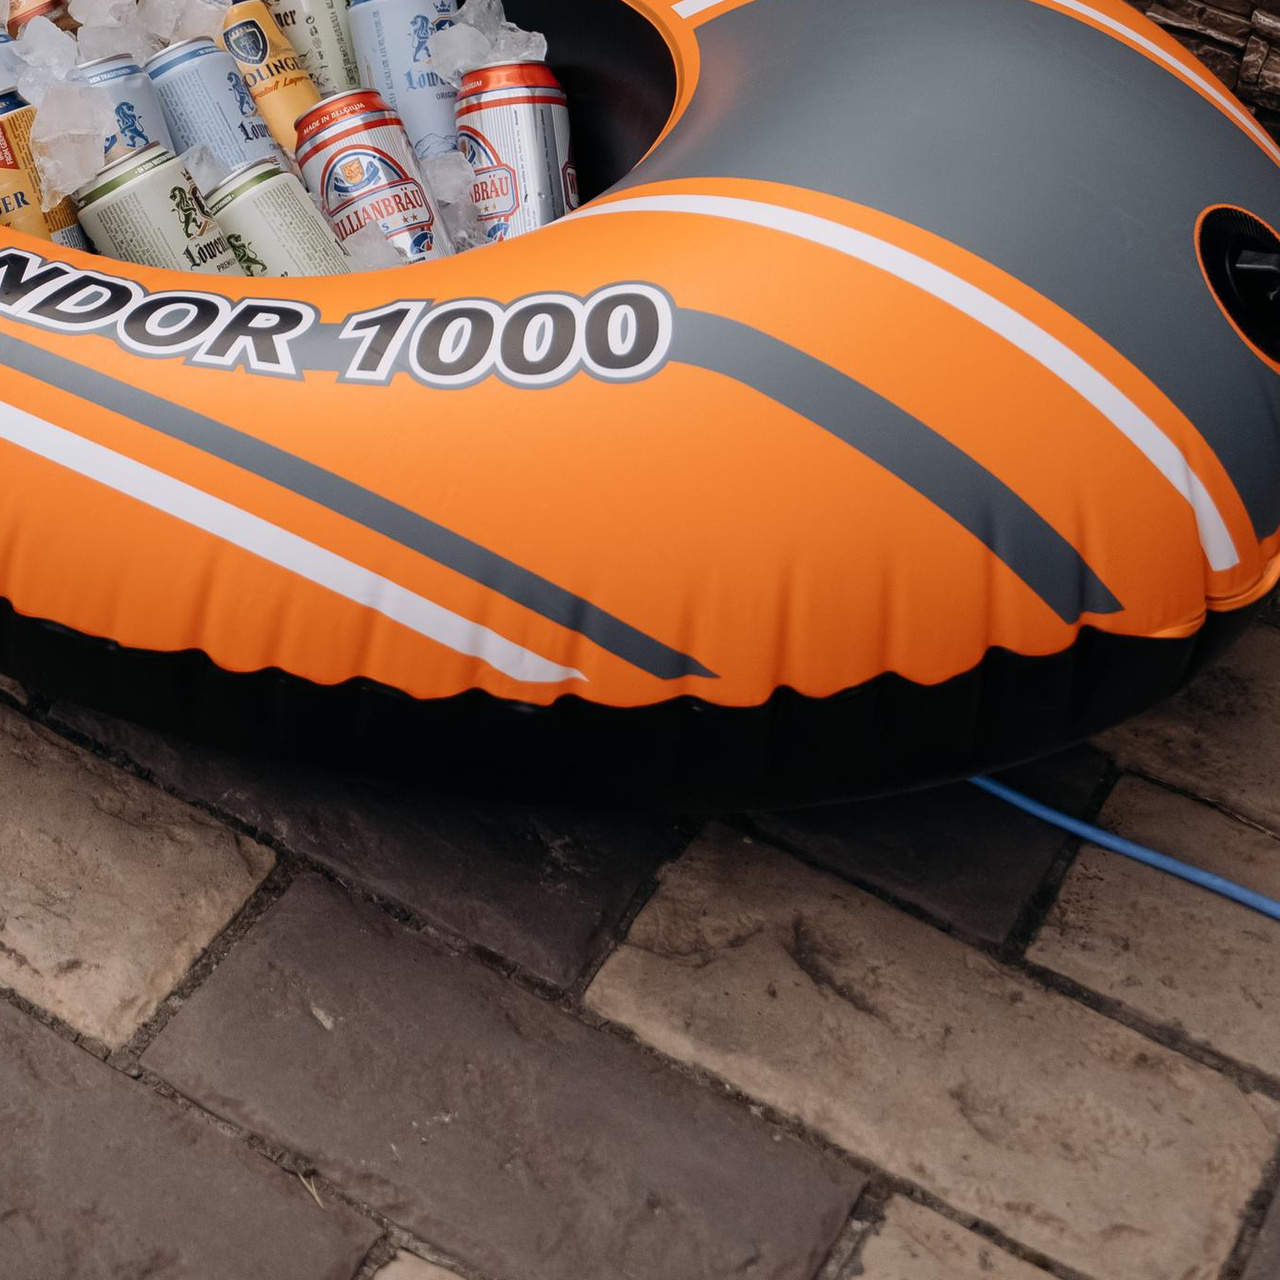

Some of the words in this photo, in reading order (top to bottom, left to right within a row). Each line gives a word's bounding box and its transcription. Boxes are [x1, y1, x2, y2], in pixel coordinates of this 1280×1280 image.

[303, 120, 320, 135] MADE
[320, 115, 330, 125] IN
[331, 102, 365, 120] BELGIUM
[336, 280, 678, 388] 1000
